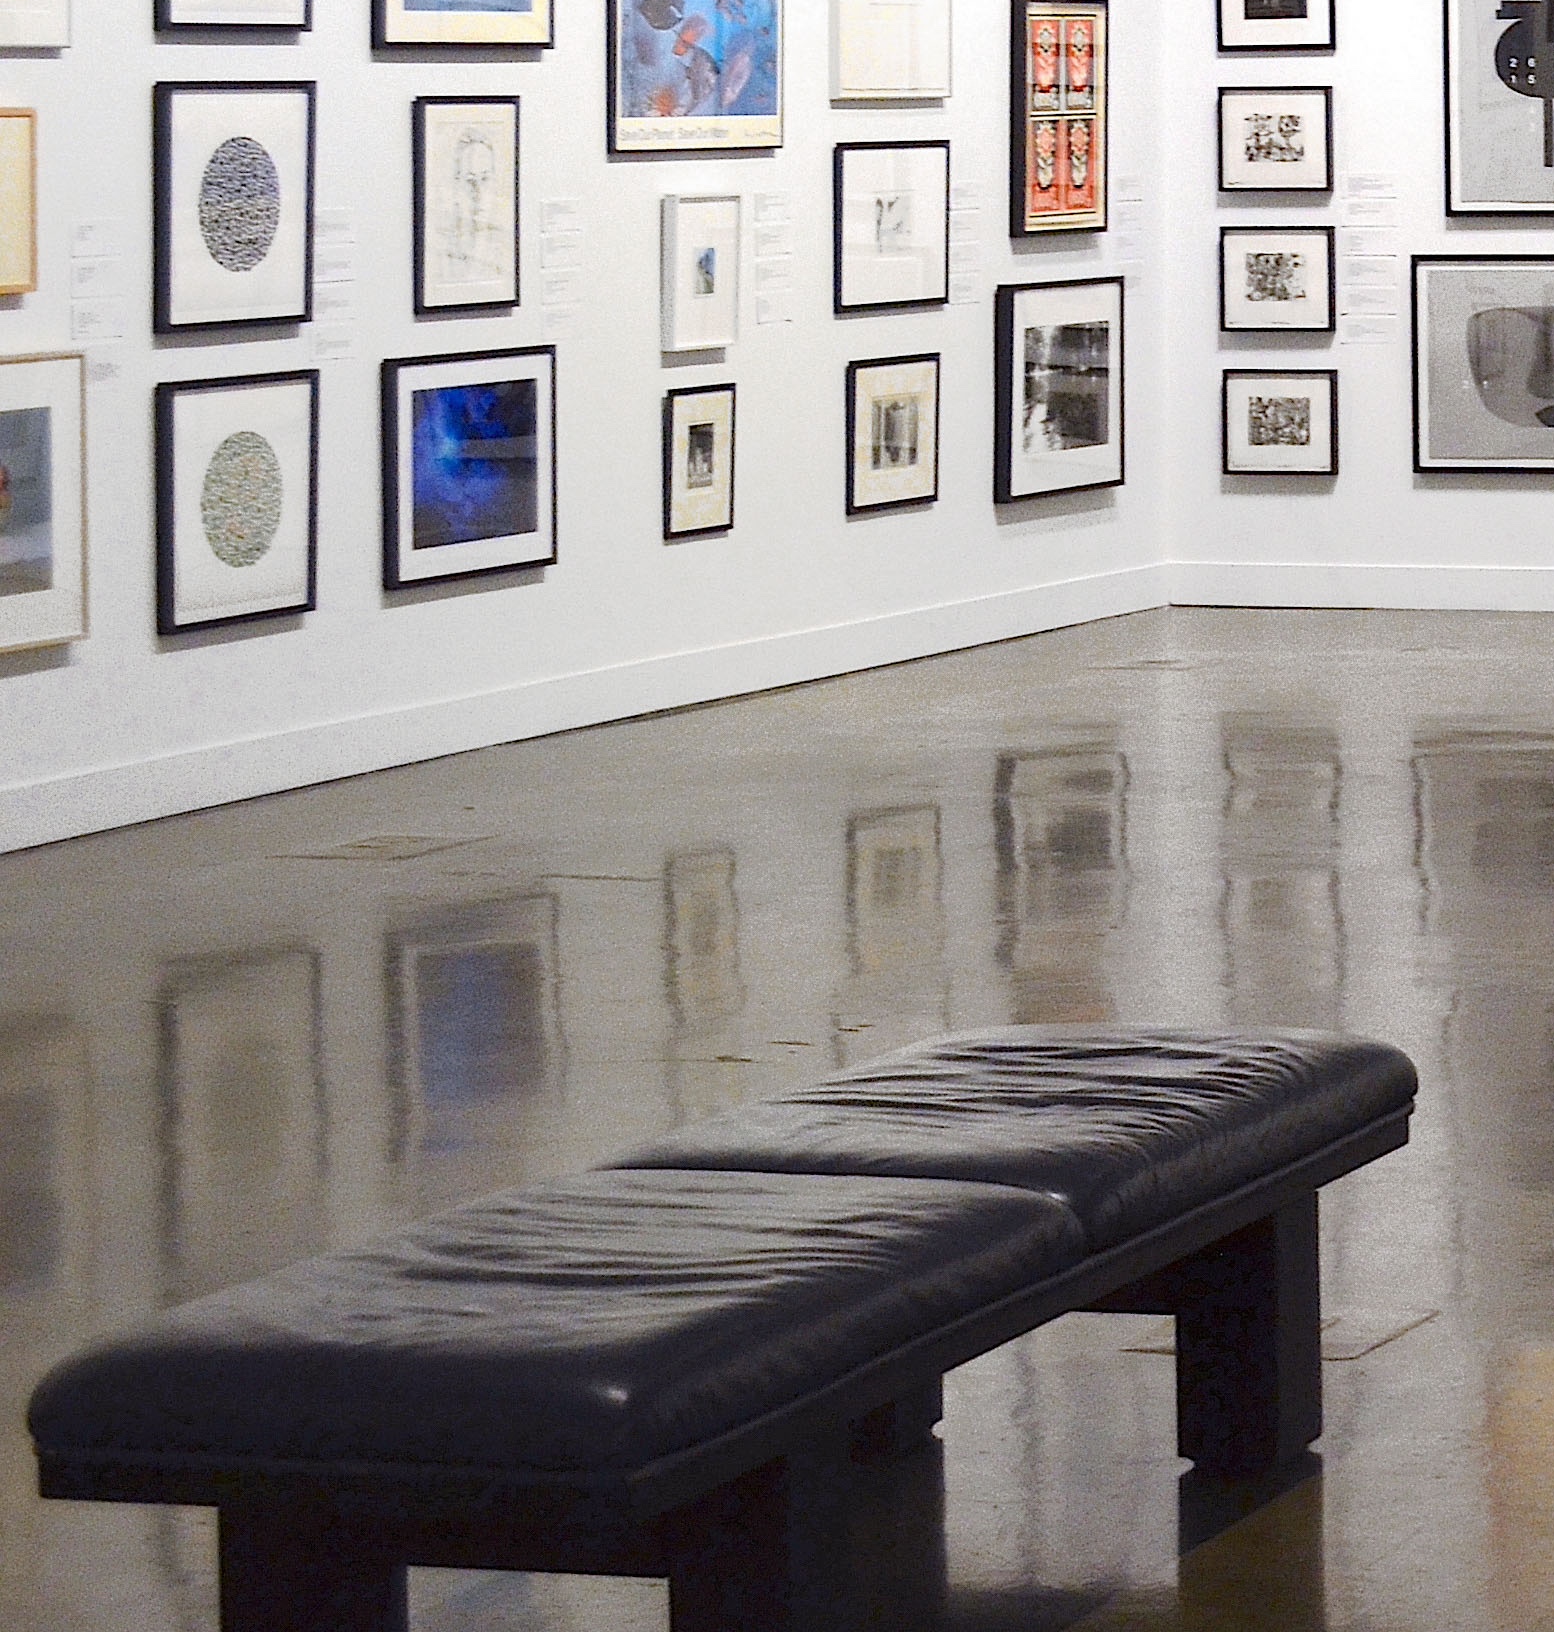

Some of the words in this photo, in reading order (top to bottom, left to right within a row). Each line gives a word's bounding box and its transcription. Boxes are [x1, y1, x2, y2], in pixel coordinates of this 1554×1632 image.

[1508, 57, 1519, 68] 2
[1509, 74, 1517, 84] 1
[1527, 74, 1536, 85] 5
